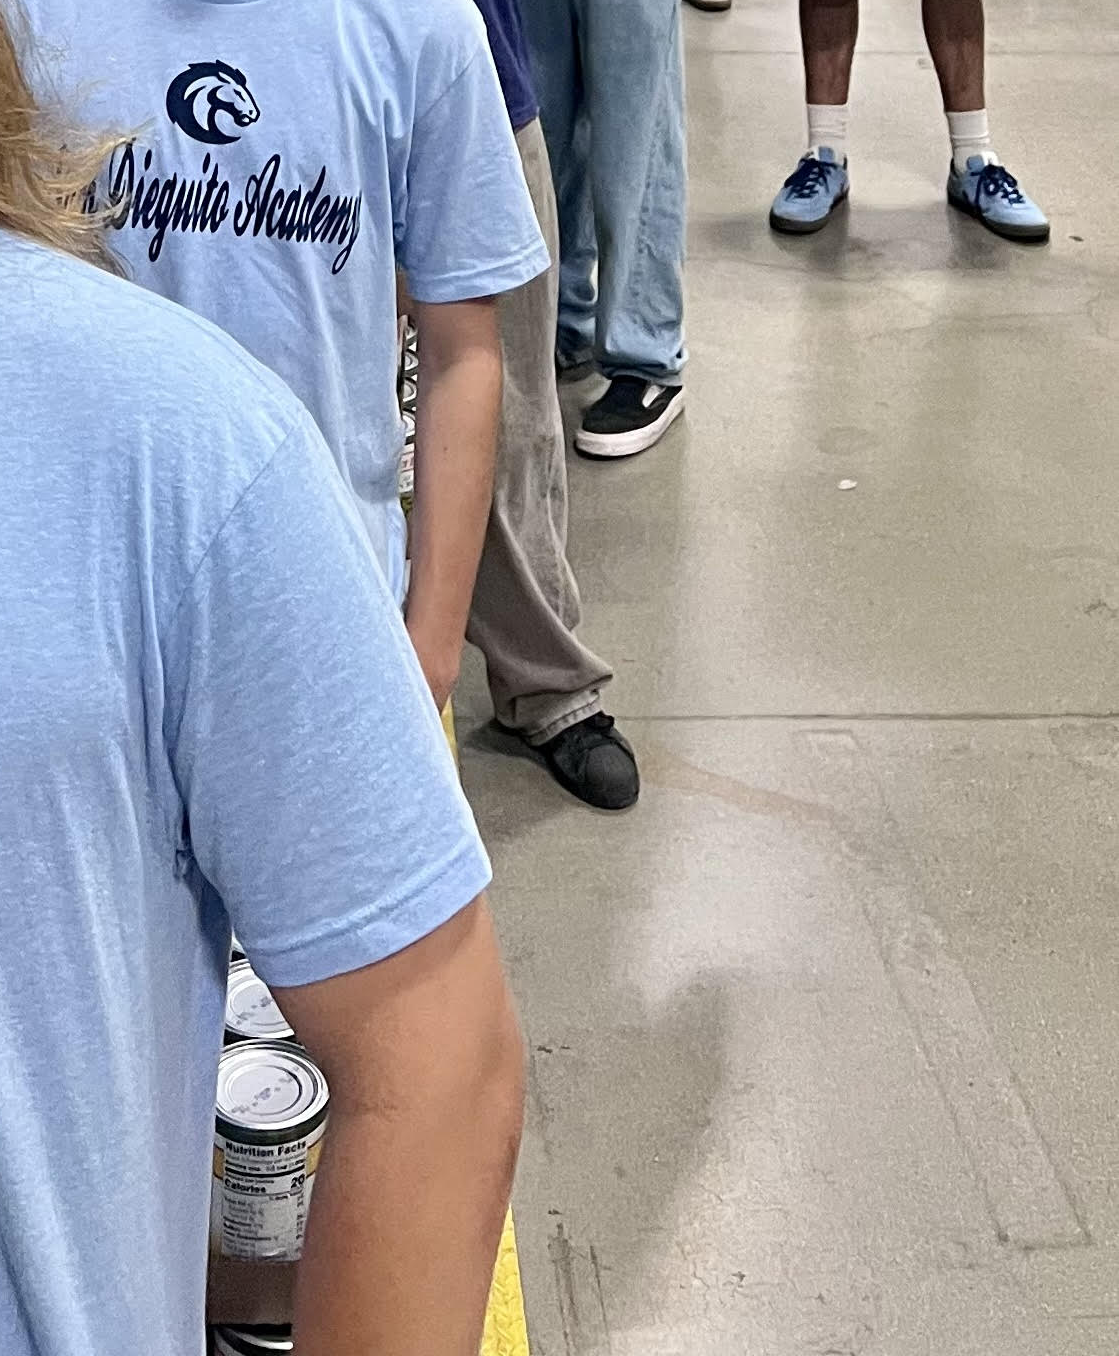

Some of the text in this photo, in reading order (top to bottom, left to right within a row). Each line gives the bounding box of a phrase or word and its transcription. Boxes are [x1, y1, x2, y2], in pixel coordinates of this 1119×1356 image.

[107, 137, 362, 275] Dieguito Academy
[225, 1140, 307, 1157] Nutrition Facts
[224, 1178, 266, 1193] Calories
[290, 1173, 306, 1188] 20
